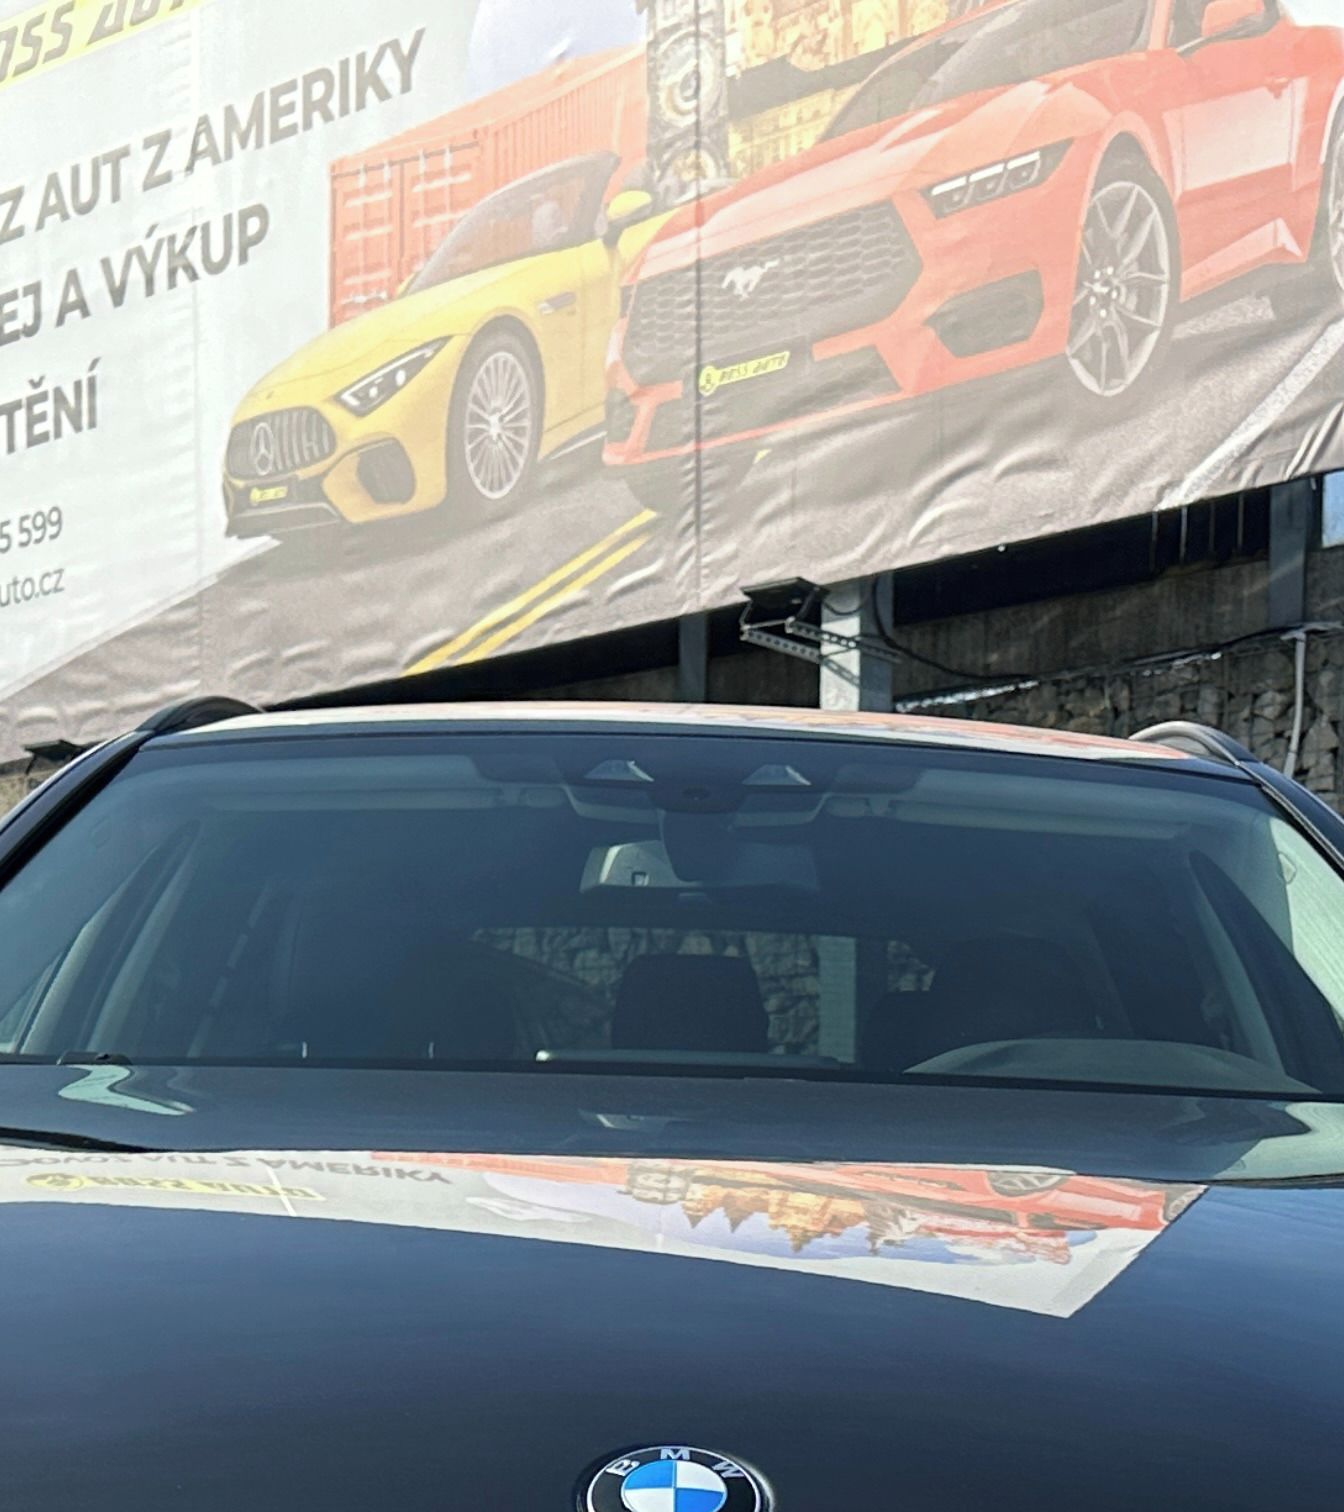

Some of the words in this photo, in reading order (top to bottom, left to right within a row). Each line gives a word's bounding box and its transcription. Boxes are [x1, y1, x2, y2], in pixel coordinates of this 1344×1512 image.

[35, 145, 131, 231] AUT
[142, 129, 173, 192] Z
[185, 27, 426, 178] AMERIKY
[56, 268, 91, 328] A
[100, 203, 270, 308] VÝKUP
[17, 506, 63, 549] 599
[606, 1447, 745, 1479] BMW
